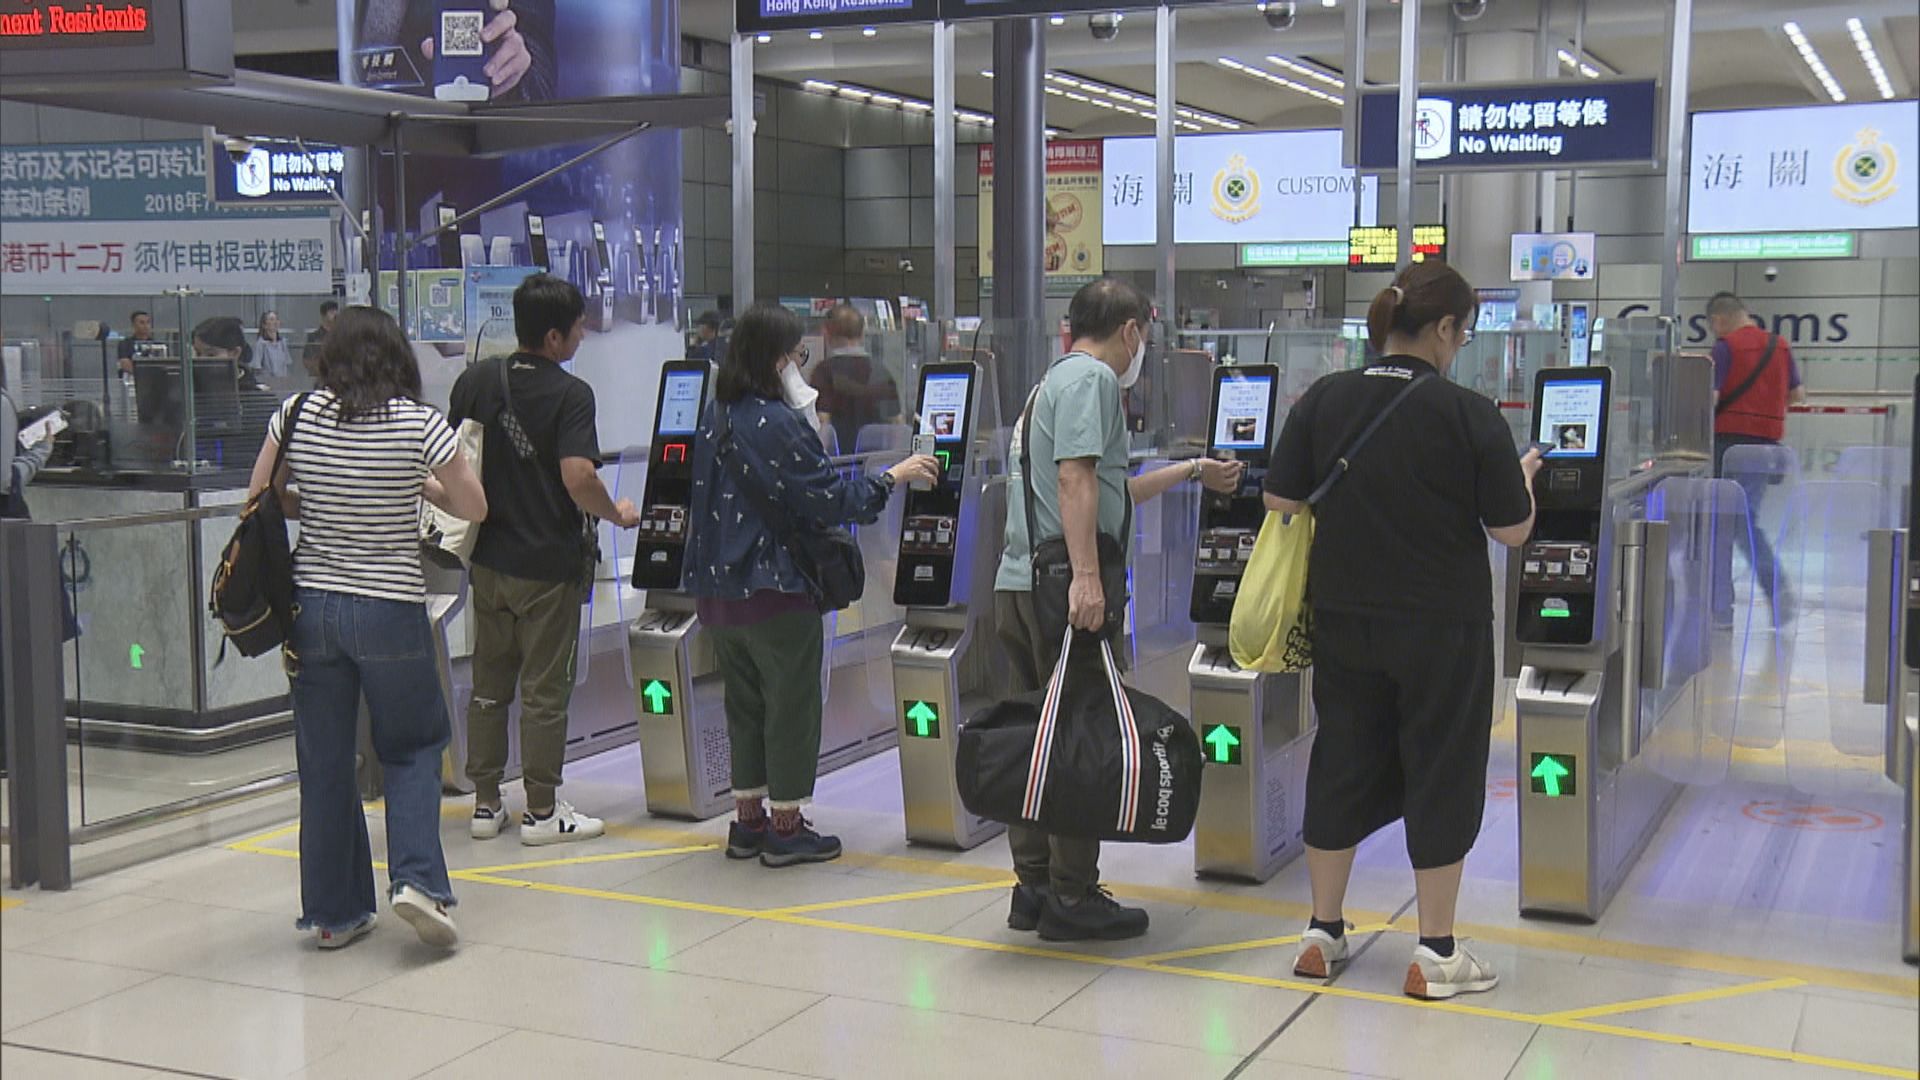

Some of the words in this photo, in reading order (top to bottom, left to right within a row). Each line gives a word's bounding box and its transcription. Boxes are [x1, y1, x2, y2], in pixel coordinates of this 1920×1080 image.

[49, 4, 146, 33] Residents
[766, 0, 799, 13] Hong
[804, 0, 837, 11] Kong
[1458, 98, 1608, 131] 請勿停留等候
[1459, 136, 1485, 153] No
[1489, 133, 1562, 155] Waiting
[1704, 149, 1808, 190] 海關
[273, 178, 290, 191] No
[134, 239, 324, 273] 须作申报或披露
[908, 628, 948, 651] 19
[1152, 741, 1174, 787] sportif
[1156, 787, 1174, 817] coq
[1150, 817, 1168, 832] le
